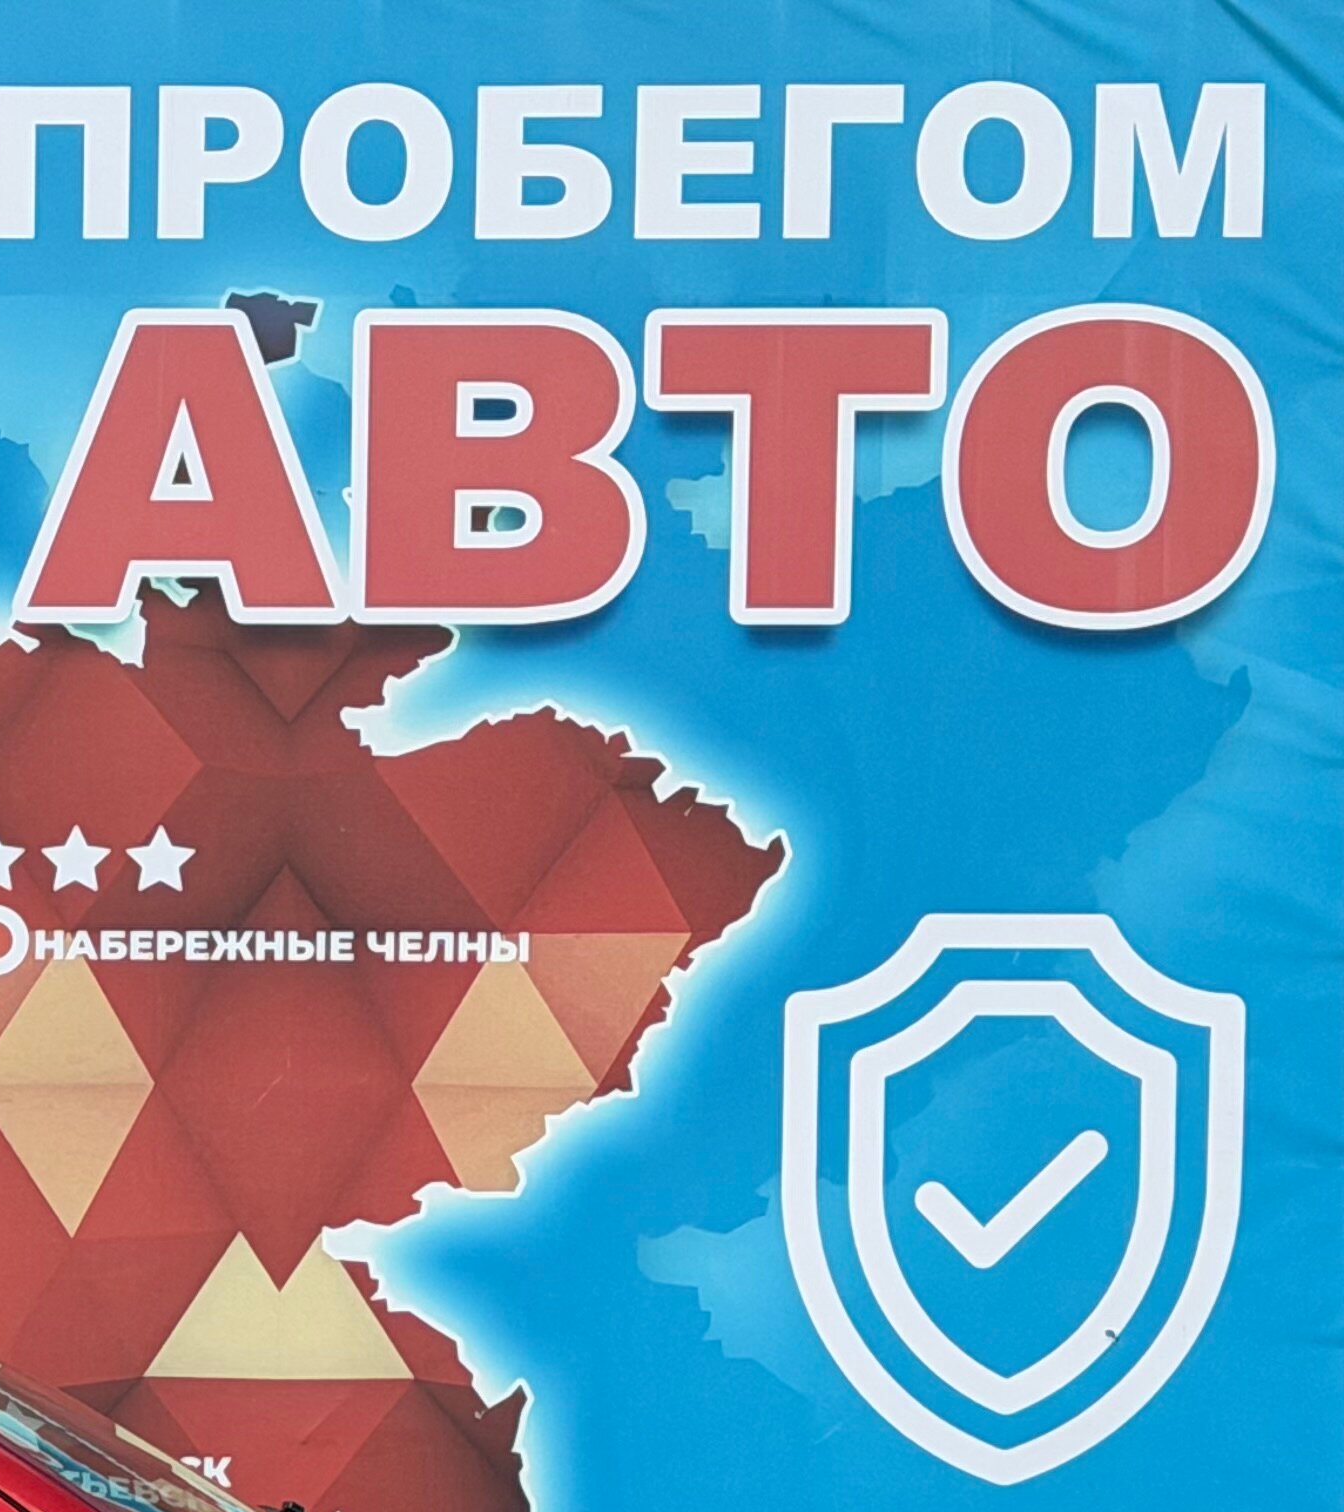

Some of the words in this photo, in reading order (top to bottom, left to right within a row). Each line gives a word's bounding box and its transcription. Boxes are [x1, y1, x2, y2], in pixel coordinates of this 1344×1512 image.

[14, 304, 1277, 631] АВТО
[34, 929, 355, 962] НАБЕРЕЖНЫЕ
[366, 931, 530, 963] ЧЕЛНЫ
